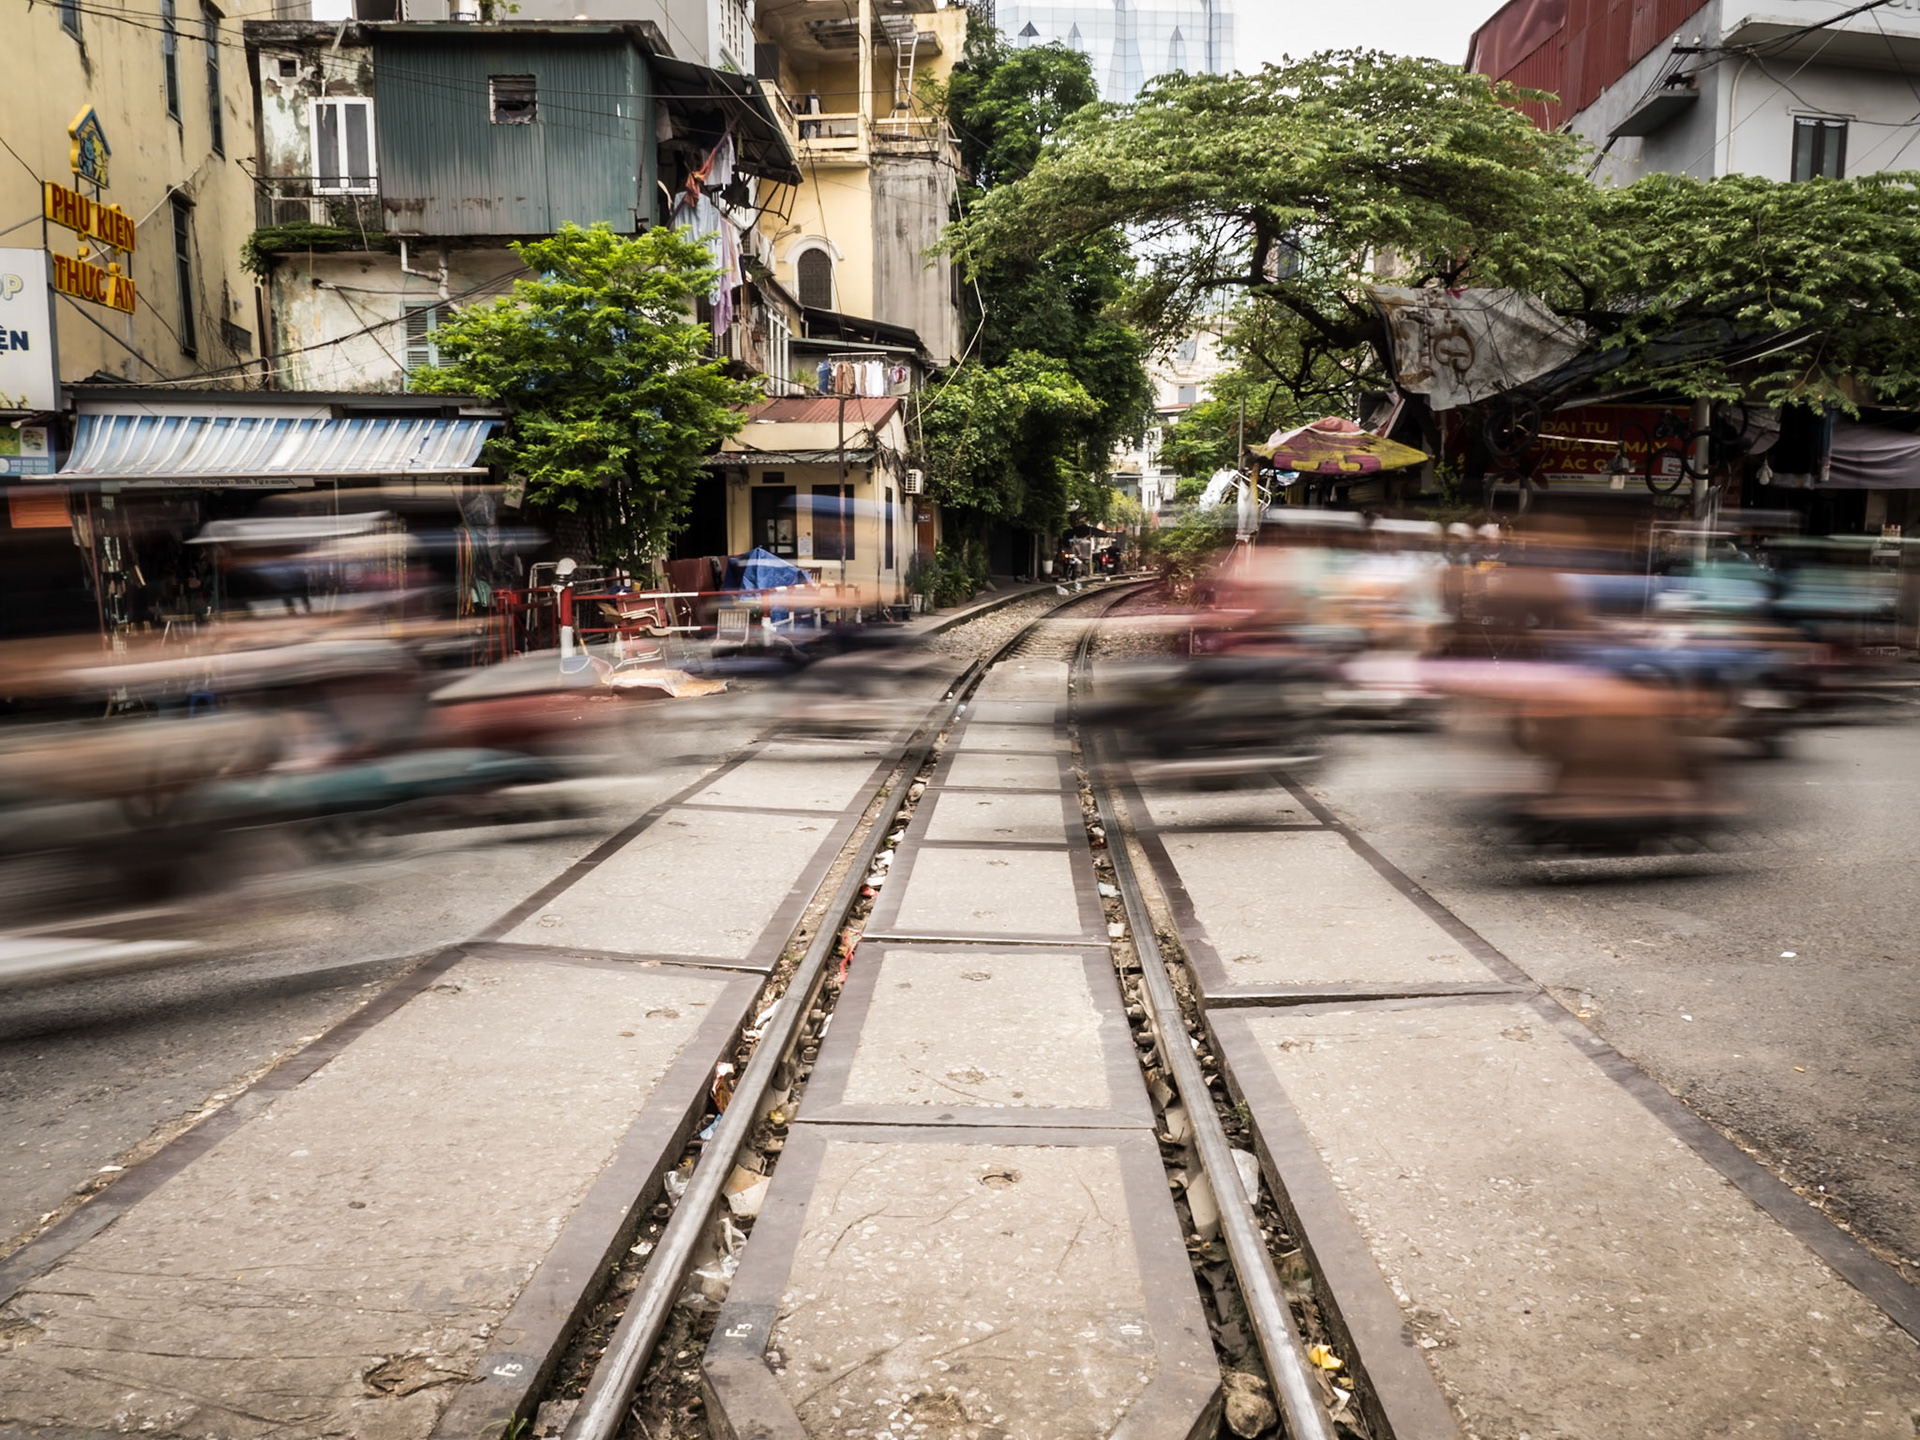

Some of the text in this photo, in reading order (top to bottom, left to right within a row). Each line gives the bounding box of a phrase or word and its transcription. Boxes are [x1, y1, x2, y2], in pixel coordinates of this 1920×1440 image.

[47, 182, 135, 255] PHỤ KIỆN
[0, 273, 24, 301] P
[53, 247, 135, 315] THỨC ĂN
[1582, 421, 1609, 434] TU
[725, 1324, 753, 1337] F3
[493, 1363, 523, 1377] F3
